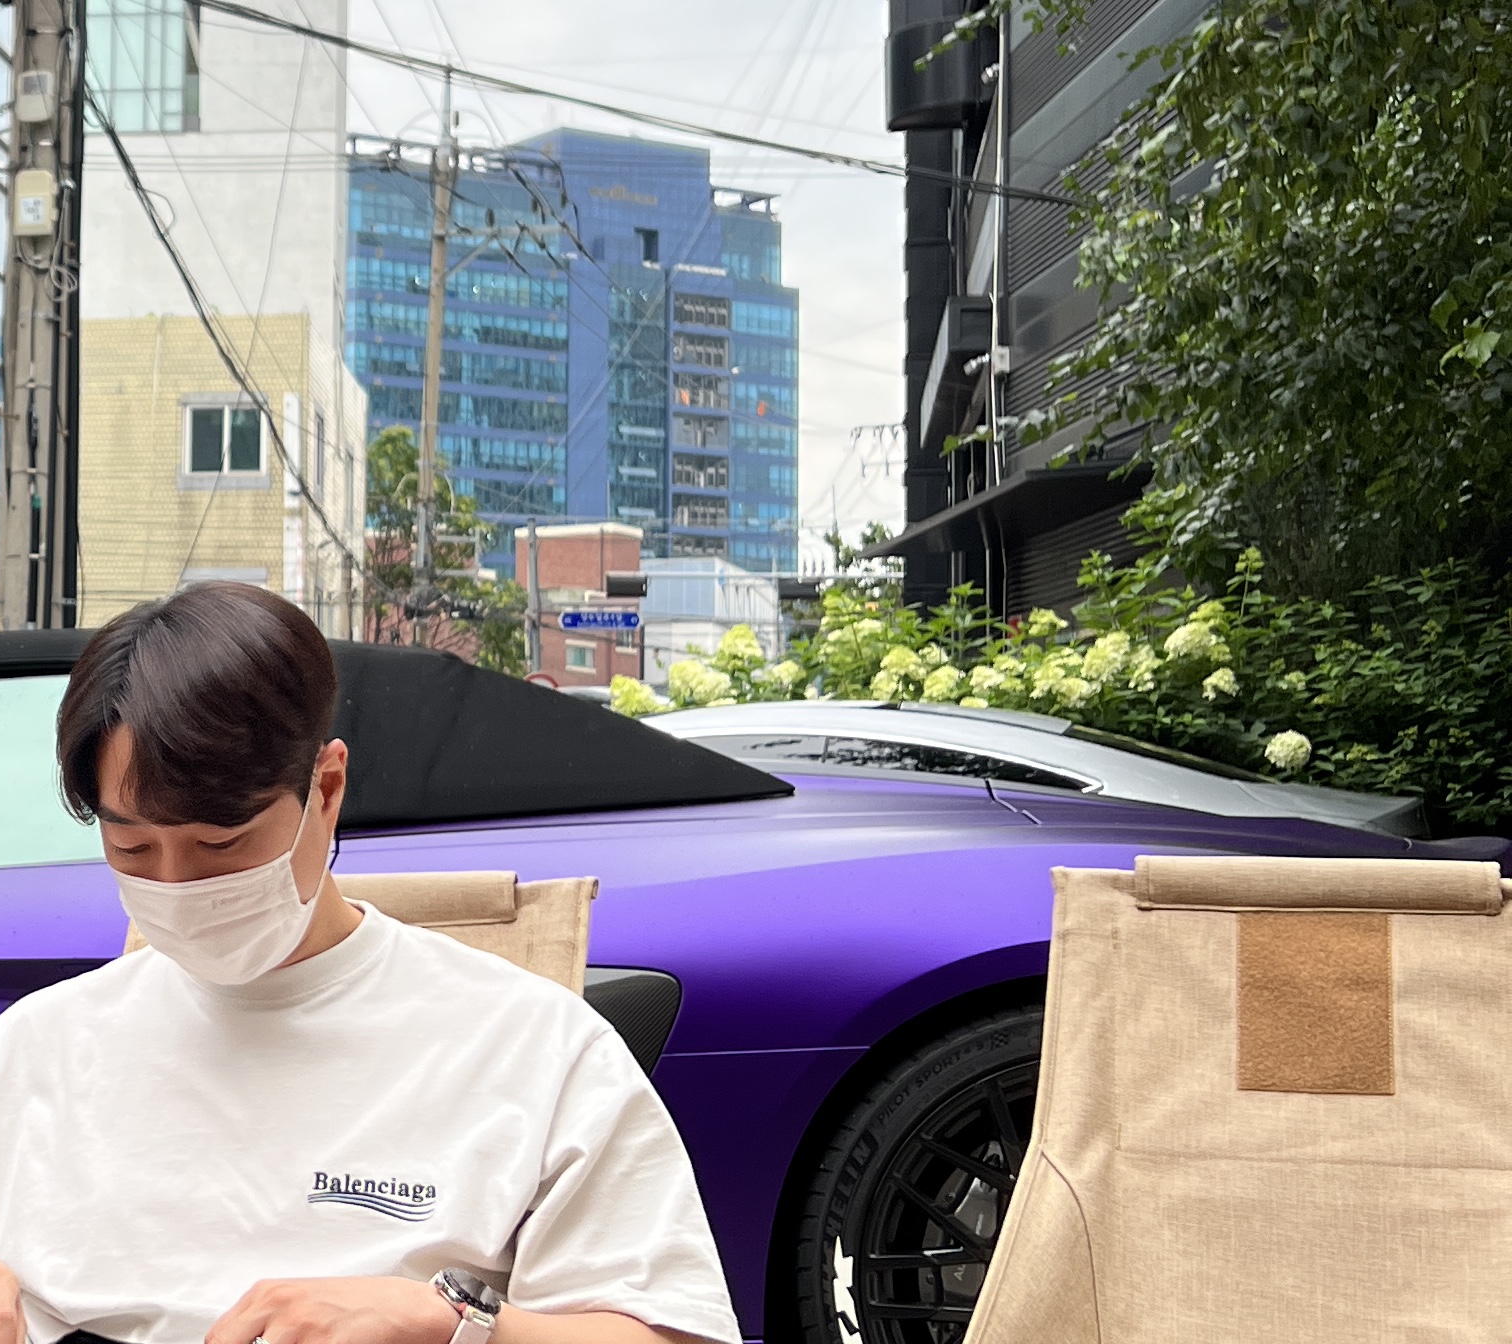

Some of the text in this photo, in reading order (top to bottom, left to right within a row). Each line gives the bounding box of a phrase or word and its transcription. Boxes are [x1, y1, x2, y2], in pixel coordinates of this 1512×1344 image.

[877, 1086, 911, 1125] PILOT
[914, 1051, 963, 1089] SPORT
[312, 1171, 437, 1203] Balenciaga
